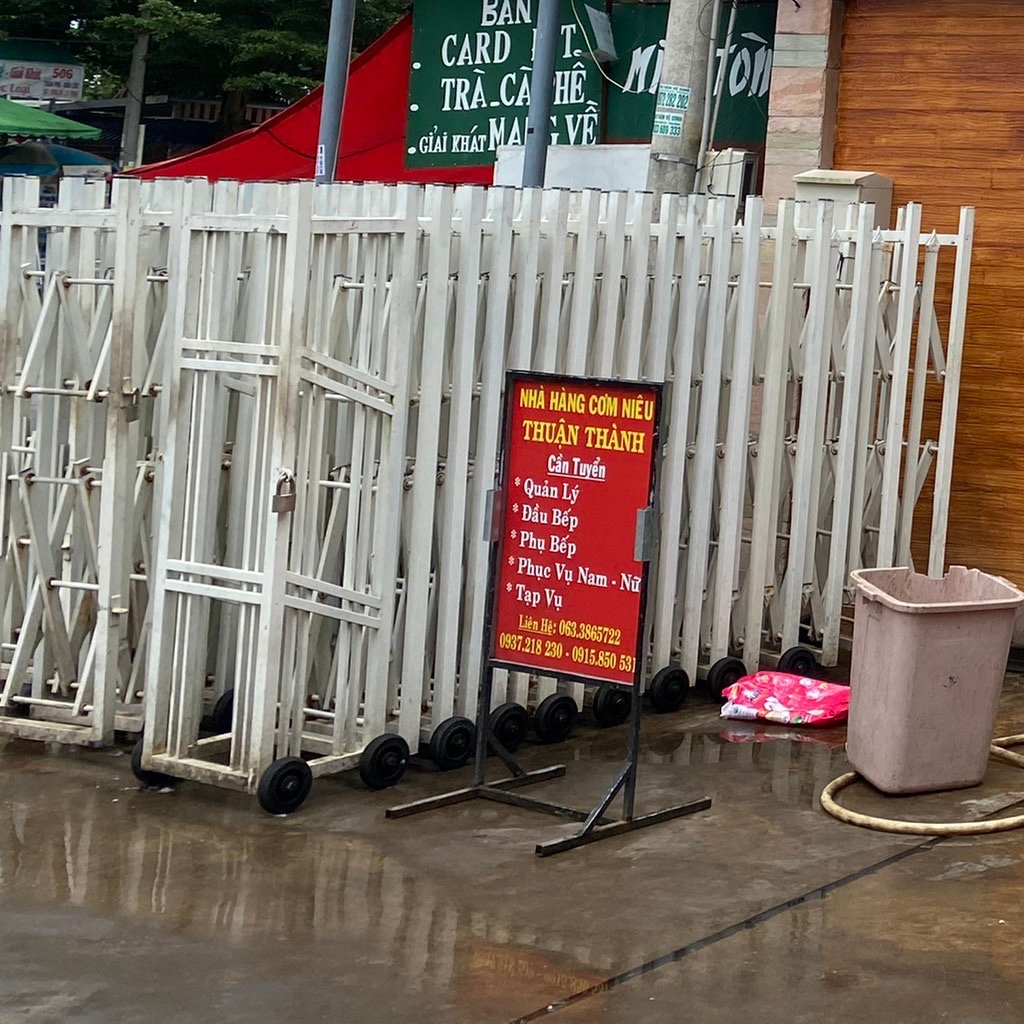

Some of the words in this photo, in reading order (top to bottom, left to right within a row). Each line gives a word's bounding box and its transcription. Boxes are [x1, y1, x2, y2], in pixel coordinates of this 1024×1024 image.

[441, 30, 511, 67] CARD
[552, 61, 587, 106] HÊ
[452, 125, 487, 153] KHÁT
[565, 99, 598, 146] VỀ
[520, 385, 545, 410] NHÀ
[549, 387, 586, 414] HÀNG
[589, 393, 618, 418] CƠM
[621, 394, 654, 421] NIÊU
[522, 418, 579, 450] THUẬN
[584, 423, 646, 454] THÀNH
[547, 453, 569, 474] Cần
[572, 456, 606, 479] Tuyển
[523, 478, 558, 499] Quản
[561, 482, 580, 505] Lý
[521, 502, 548, 524] Đầu
[551, 507, 579, 532] Bếp
[519, 530, 546, 555] Phụ
[549, 534, 577, 559] Bếp
[517, 557, 551, 582] Phục
[554, 562, 573, 586] Vụ
[577, 566, 608, 588] Nam
[619, 572, 642, 593] Nữ
[515, 583, 541, 608] Tạp
[544, 588, 563, 612] Vụ
[518, 614, 539, 631] Liên
[558, 619, 621, 646] 063.3865722
[499, 632, 542, 655] 0937.218
[544, 640, 563, 659] 230
[571, 645, 617, 670] 0915.850
